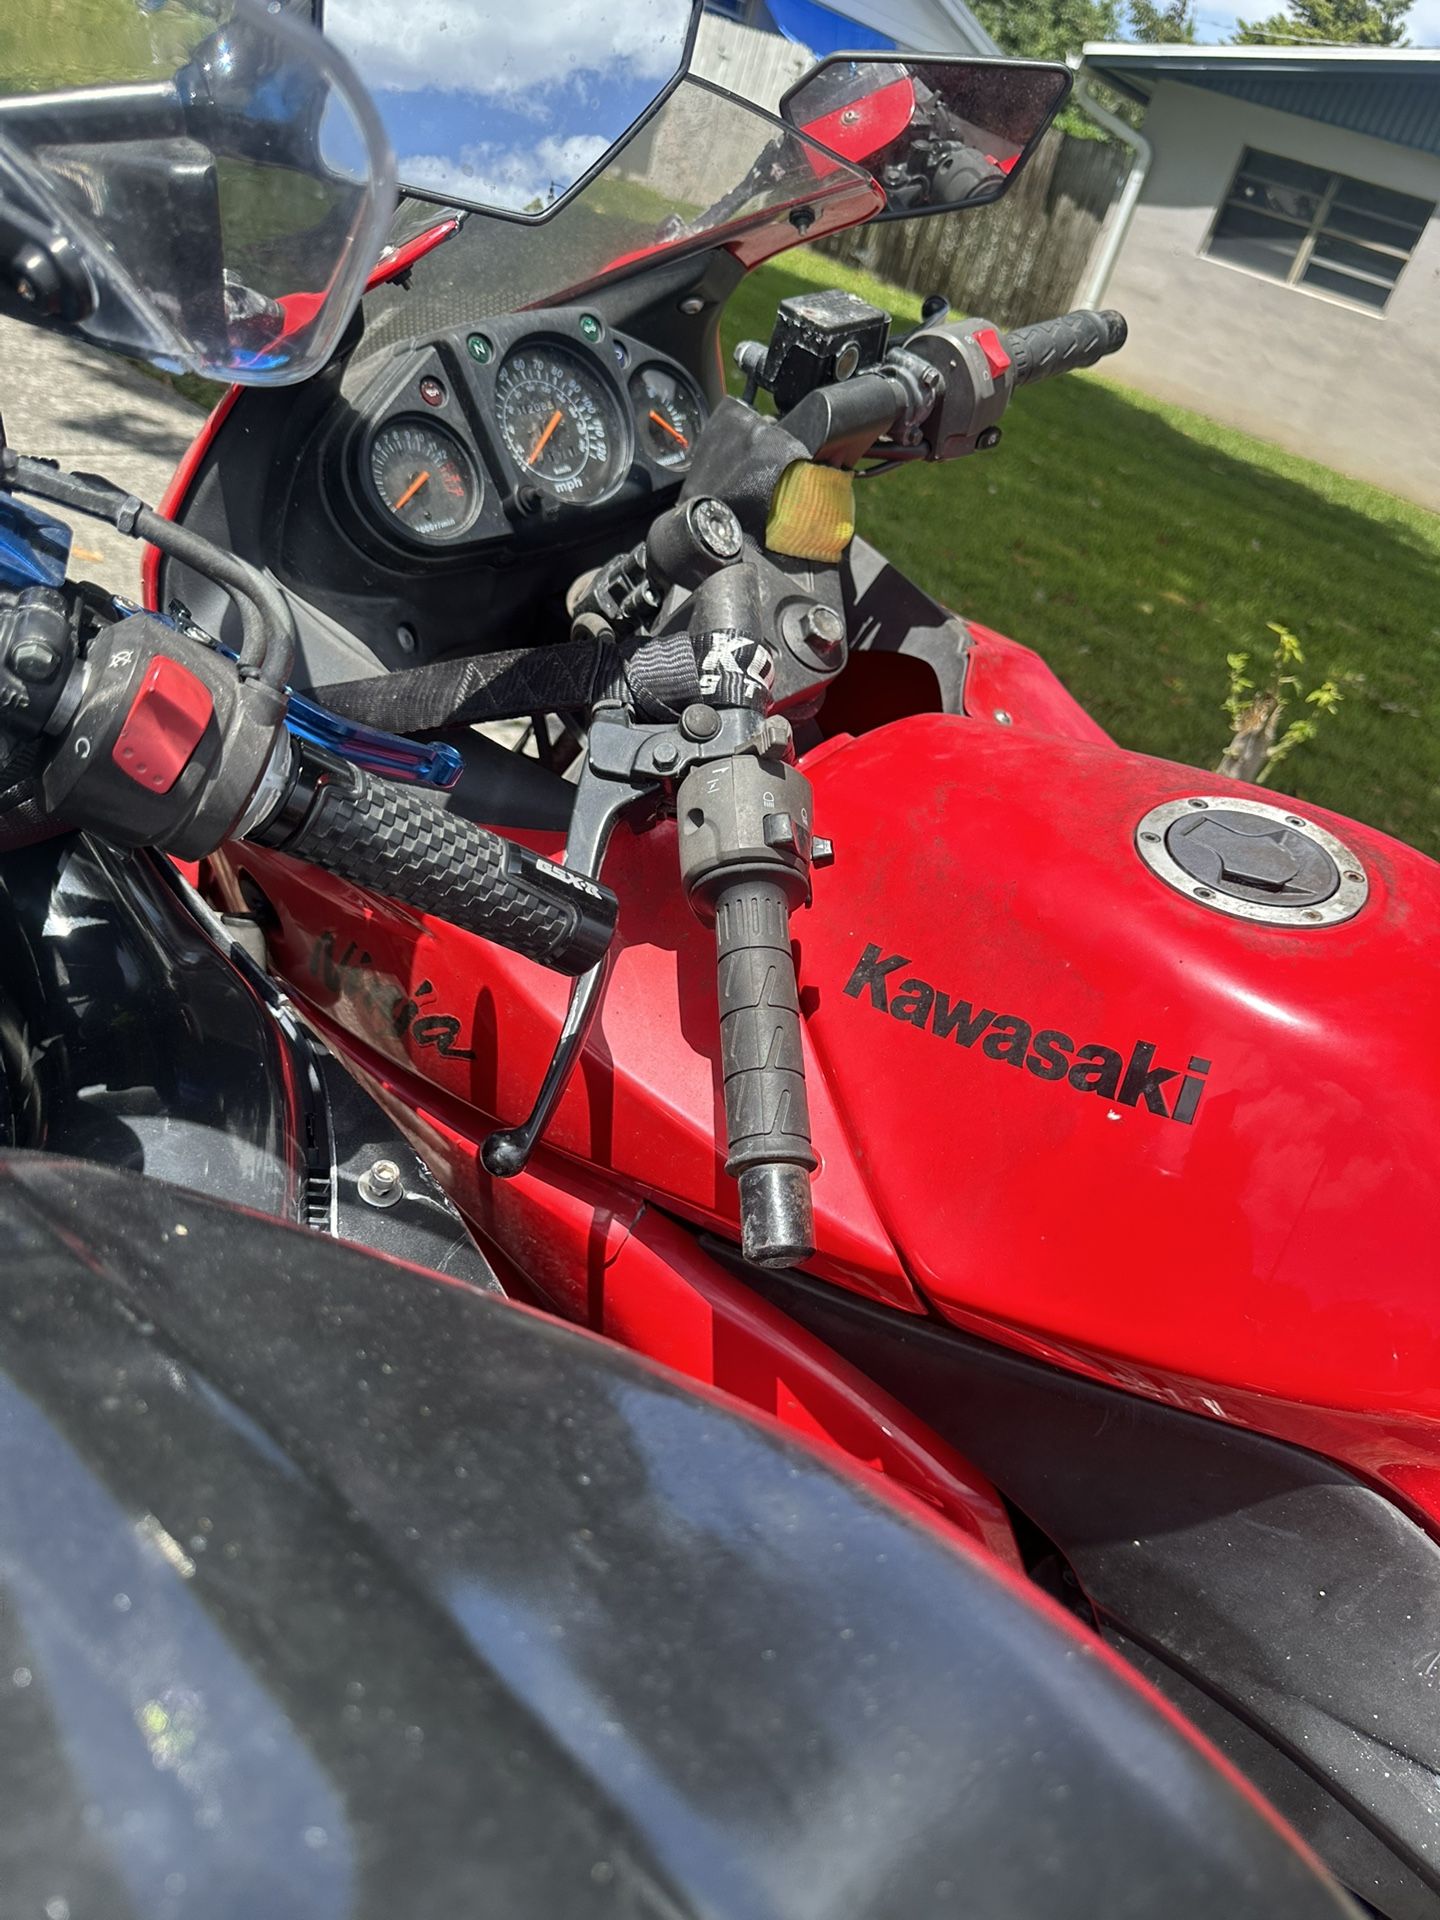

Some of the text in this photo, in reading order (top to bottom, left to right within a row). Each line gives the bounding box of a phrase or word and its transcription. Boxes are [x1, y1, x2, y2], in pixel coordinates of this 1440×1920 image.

[473, 342, 486, 356] N
[512, 358, 526, 371] 60
[532, 357, 545, 370] 70
[553, 477, 584, 493] mph
[842, 941, 1213, 1126] Kawasaki
